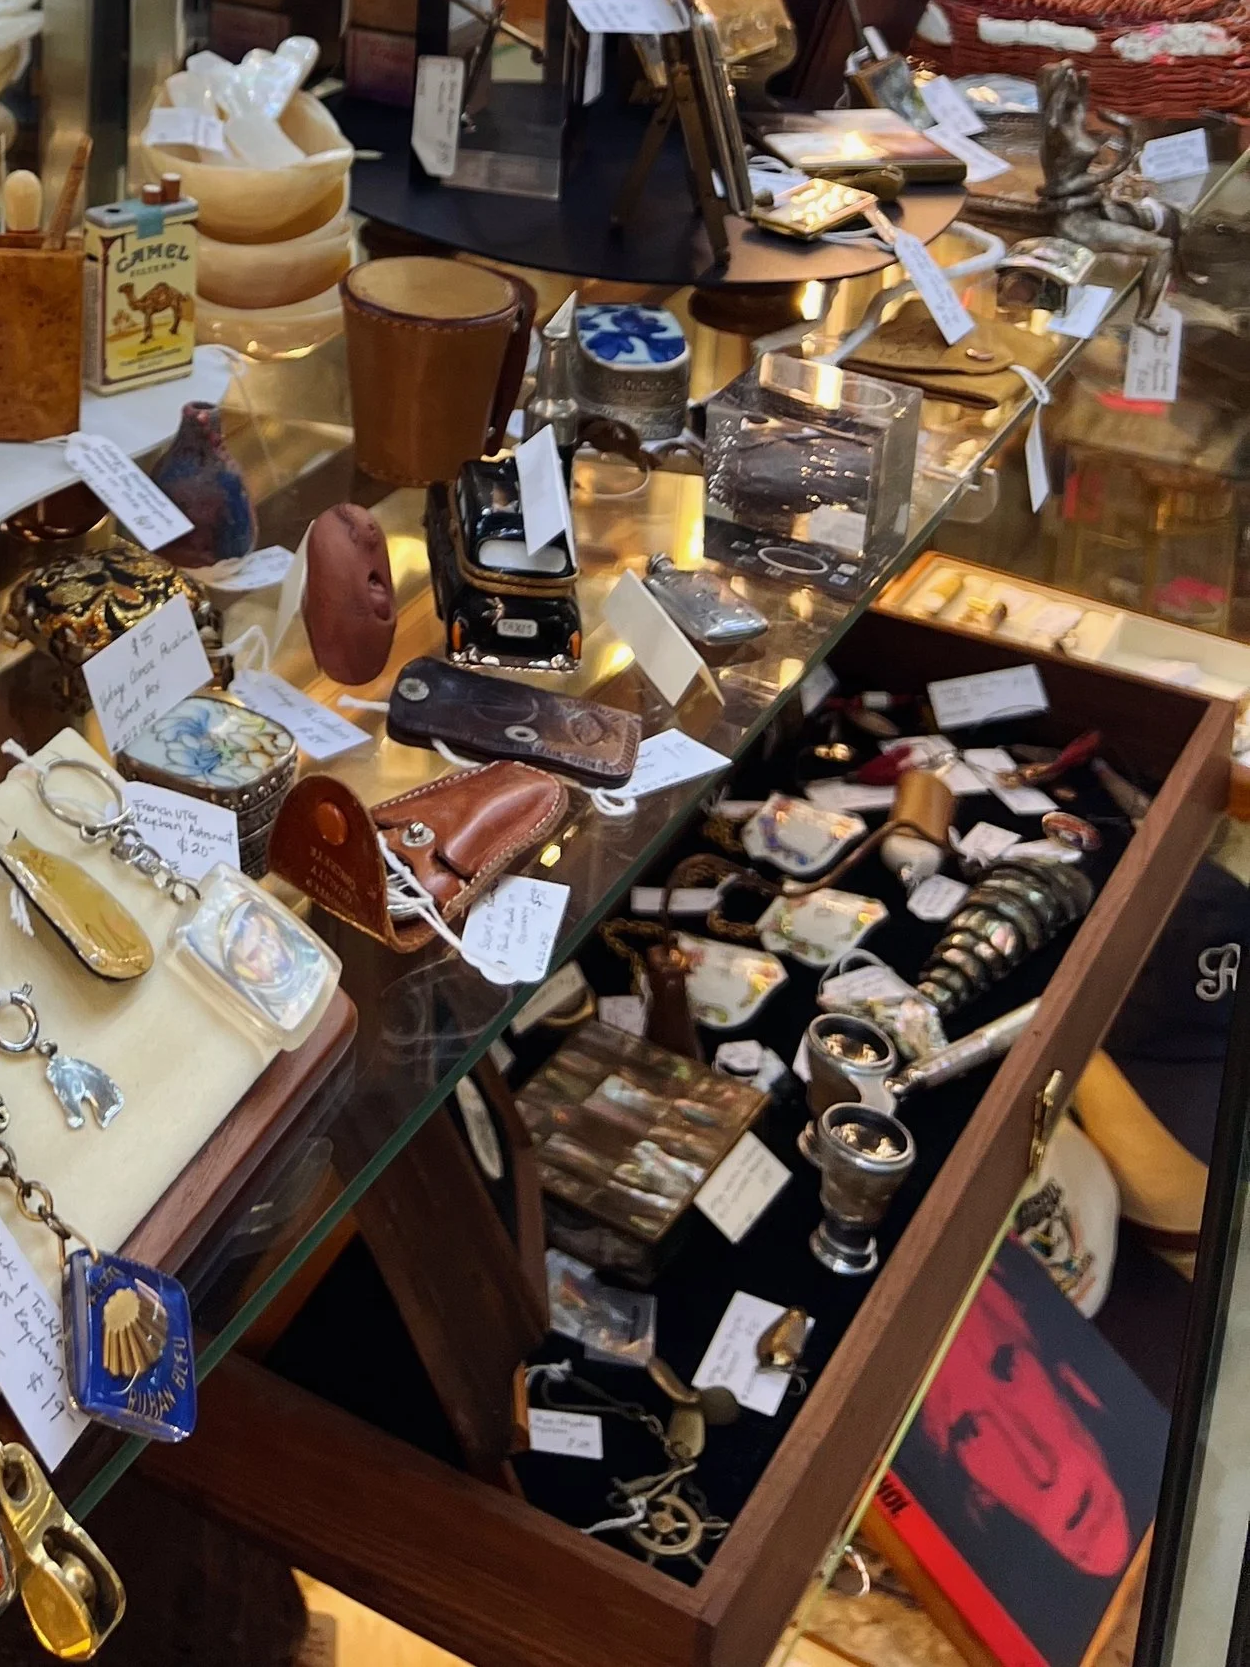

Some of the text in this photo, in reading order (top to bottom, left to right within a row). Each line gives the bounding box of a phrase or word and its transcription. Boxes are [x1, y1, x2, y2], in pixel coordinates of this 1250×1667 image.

[114, 242, 191, 274] CAMEL
[132, 798, 173, 819] French
[13, 1306, 66, 1383] Keychain
[171, 1336, 189, 1392] BLEU
[127, 1384, 177, 1420] RUBAN
